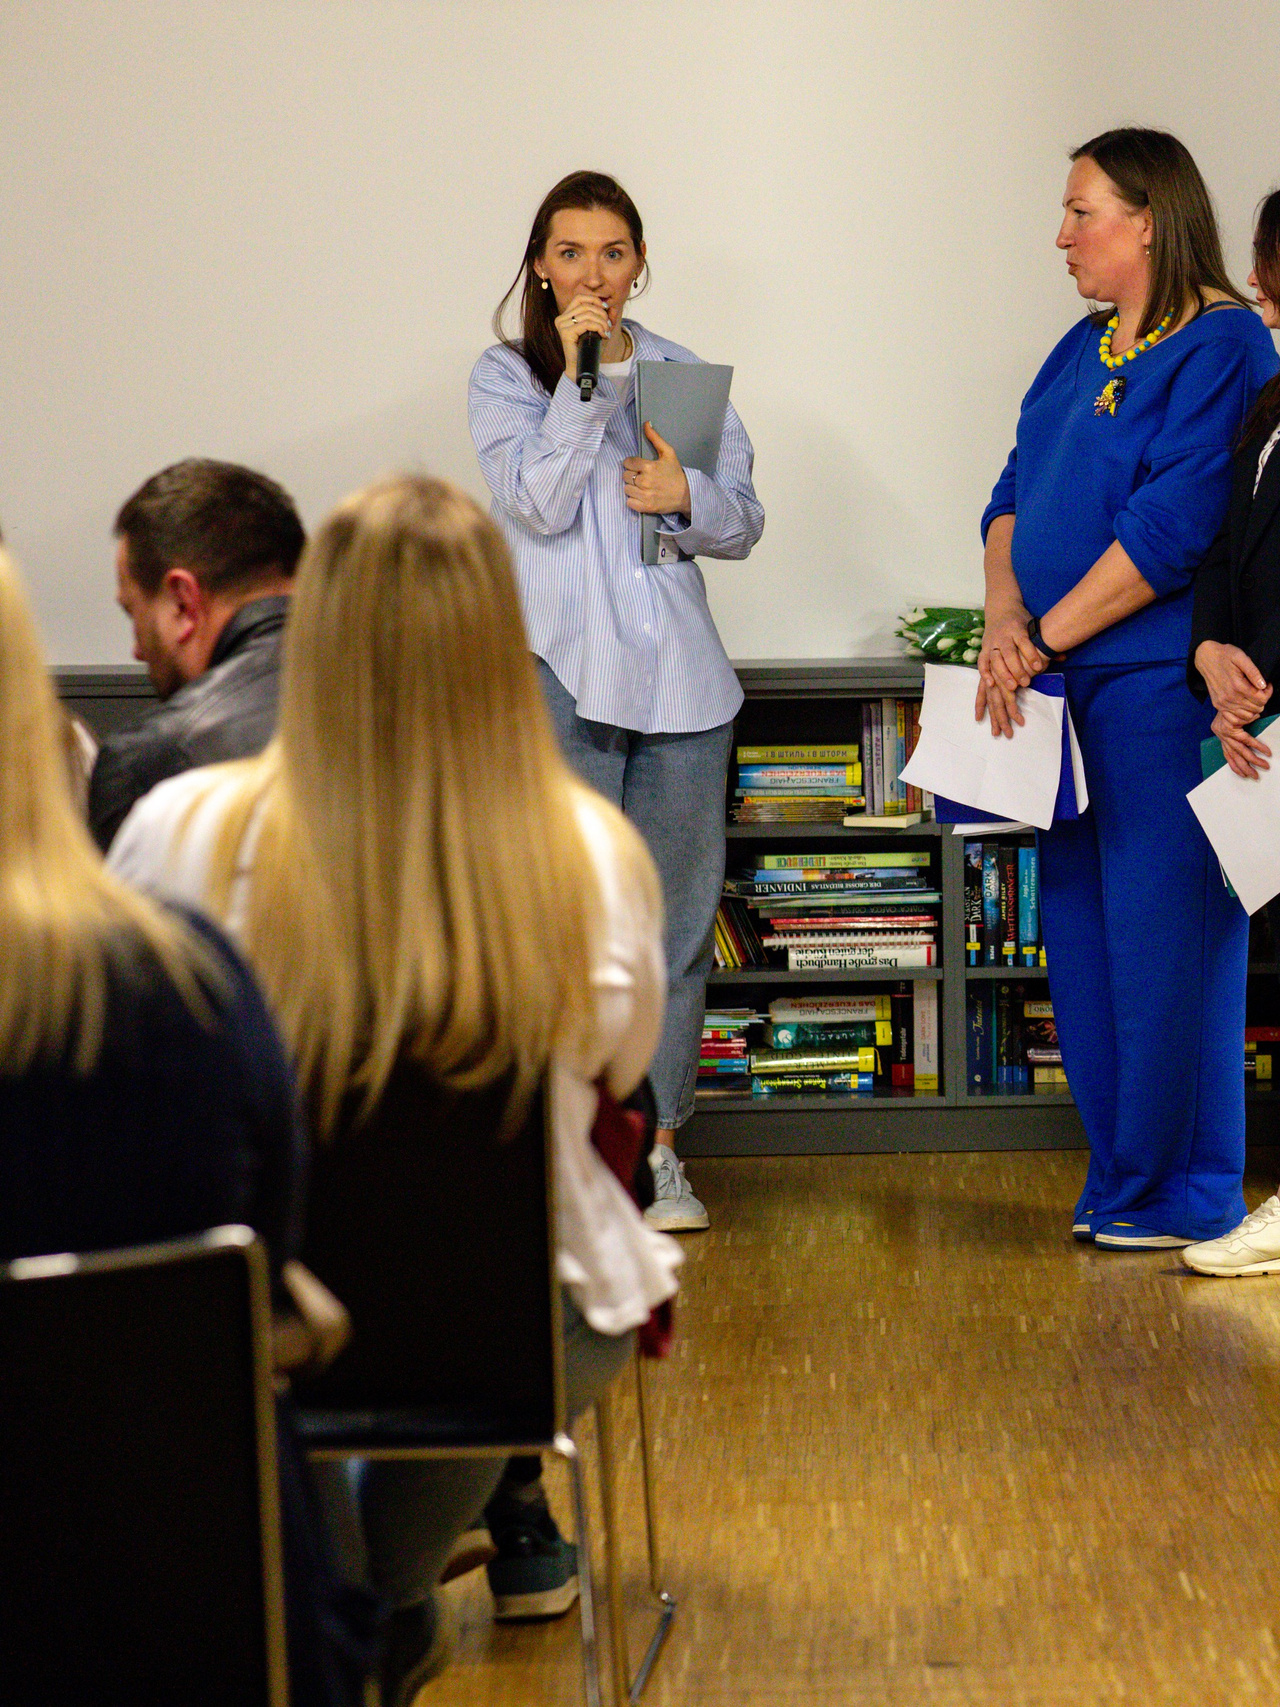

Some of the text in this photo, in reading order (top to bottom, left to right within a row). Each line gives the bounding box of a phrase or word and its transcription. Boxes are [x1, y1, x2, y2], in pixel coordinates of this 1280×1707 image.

[777, 750, 804, 758] ШТИЛЬ
[776, 856, 826, 867] LIEDERBUCH
[755, 883, 806, 893] INDIANER
[984, 872, 992, 898] DARK
[970, 899, 982, 922] DARK
[857, 947, 874, 957] der
[796, 957, 898, 969] Das große Handbuch
